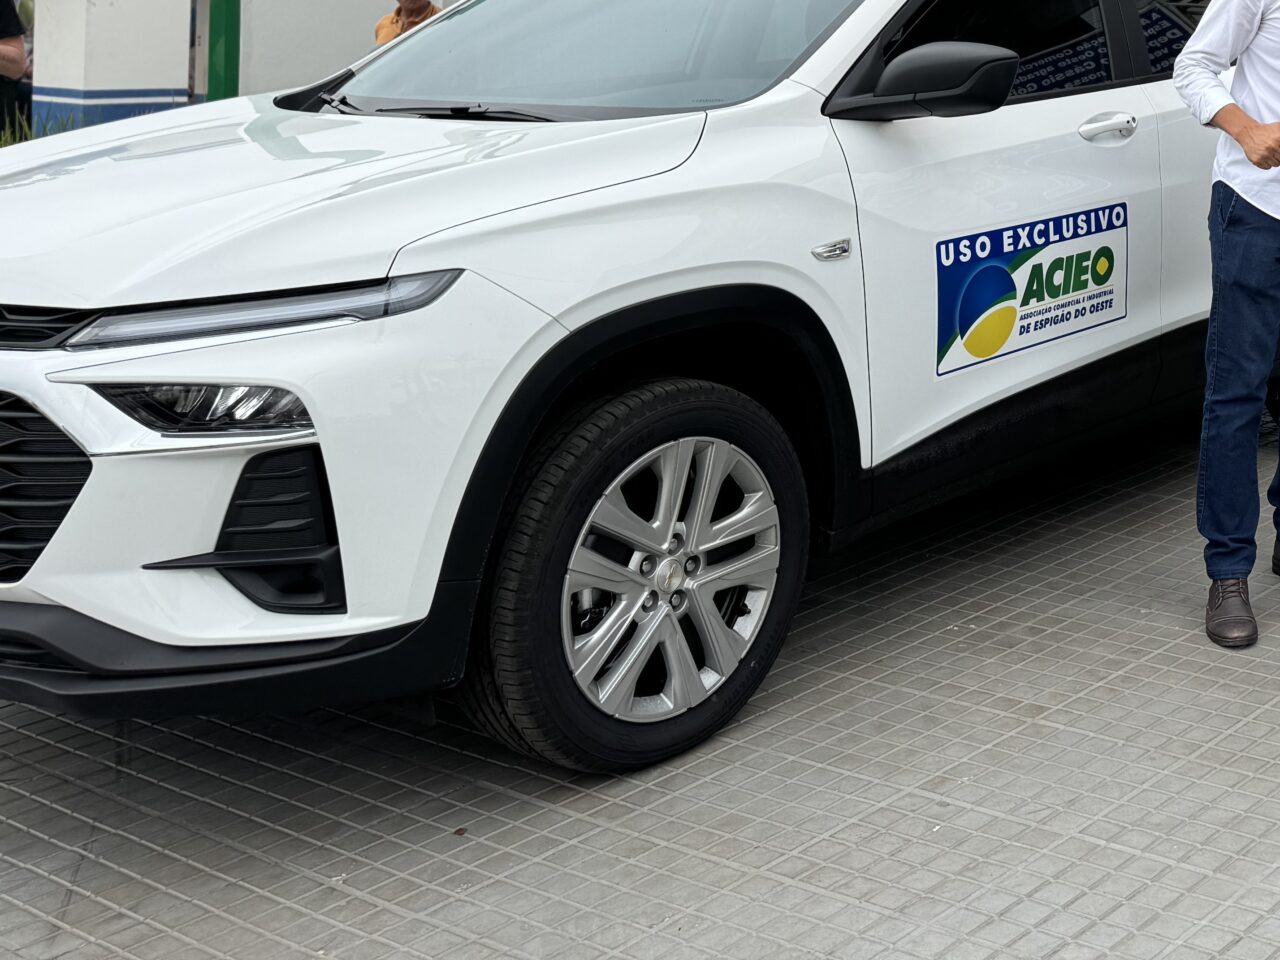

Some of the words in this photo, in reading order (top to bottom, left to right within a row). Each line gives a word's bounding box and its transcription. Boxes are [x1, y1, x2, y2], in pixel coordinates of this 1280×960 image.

[940, 235, 991, 267] USO
[1002, 205, 1125, 253] EXCLUSIVO
[1019, 245, 1115, 308] ACIEO
[1019, 305, 1052, 321] ASSOCIAÇÃO
[1053, 297, 1081, 311] COMERCIAL
[1086, 288, 1114, 302] INDUSTRIAL
[1019, 323, 1031, 336] DE
[1033, 310, 1072, 331] ESPIGÃO
[1074, 306, 1087, 319] DO
[1089, 298, 1114, 314] OESTE
